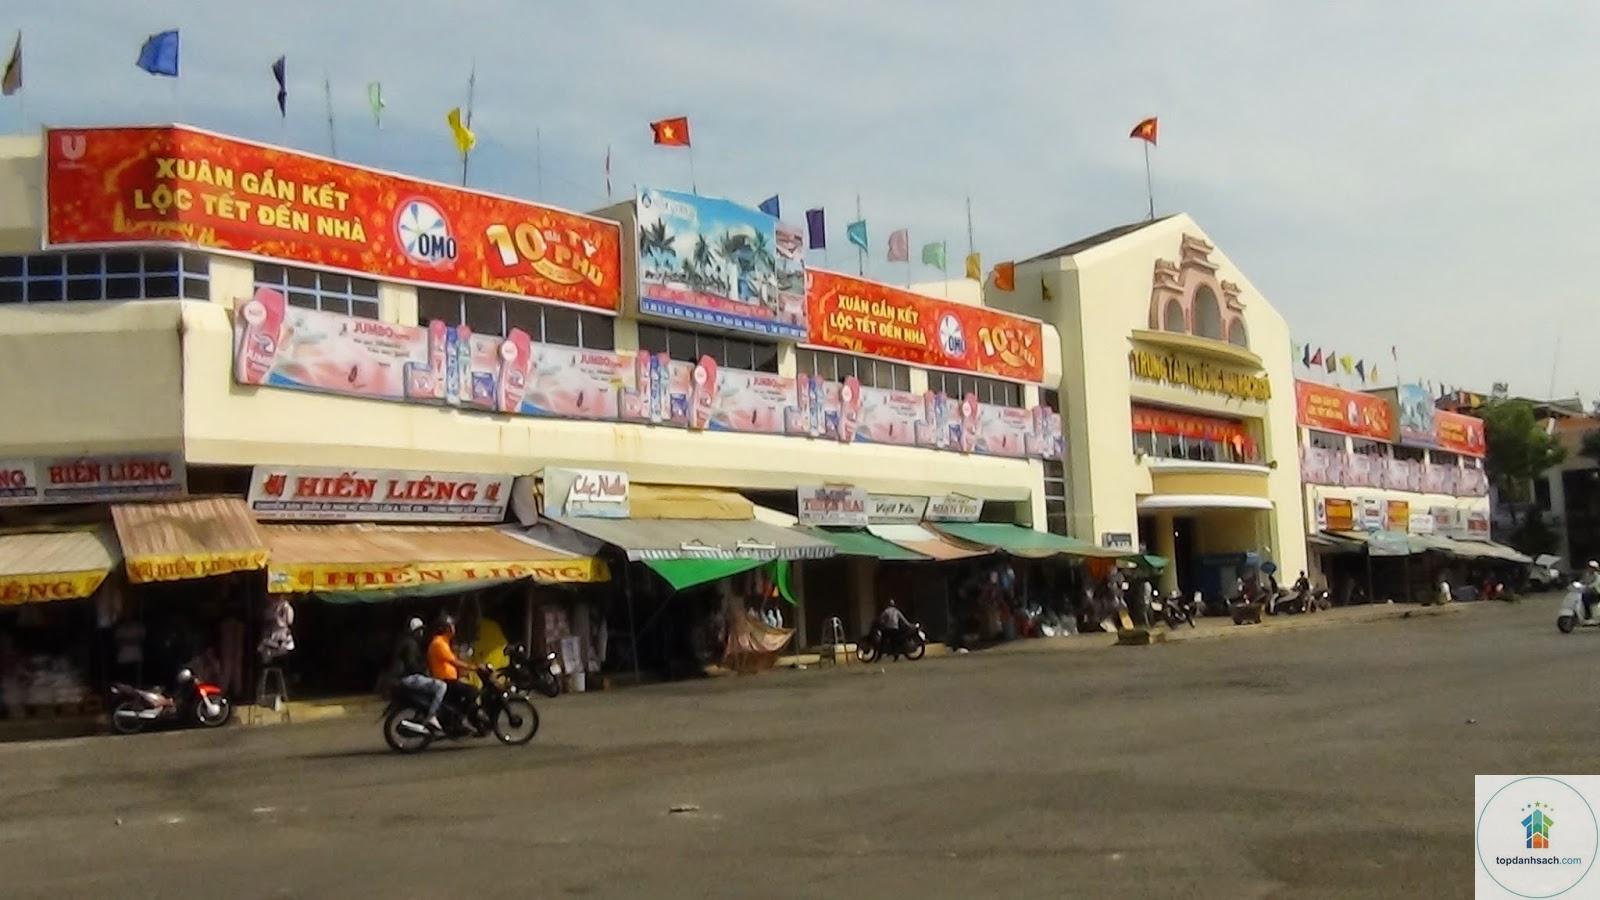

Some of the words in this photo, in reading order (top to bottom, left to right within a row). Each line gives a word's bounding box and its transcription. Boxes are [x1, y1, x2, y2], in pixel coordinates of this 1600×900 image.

[155, 158, 234, 189] XUÂN
[303, 181, 350, 212] KẾT
[134, 183, 193, 215] LỘC
[200, 189, 251, 222] TẾT
[256, 202, 310, 233] ĐẾN
[316, 216, 367, 243] NHÀ
[418, 233, 457, 260] OMO
[486, 222, 548, 267] 10
[838, 294, 870, 314] XUÂN
[898, 304, 919, 325] KẾT
[353, 320, 393, 338] JUMBO
[830, 312, 853, 333] LỘC
[855, 315, 877, 335] TẾT
[878, 319, 902, 340] ĐẾN
[904, 326, 927, 346] NHÀ
[978, 325, 1010, 357] 10
[108, 460, 172, 481] LIÊNG
[293, 472, 377, 499] HIẾN
[387, 474, 478, 502] LIÊNG
[325, 563, 443, 586] HIẾN
[464, 563, 586, 582] LIÊNG
